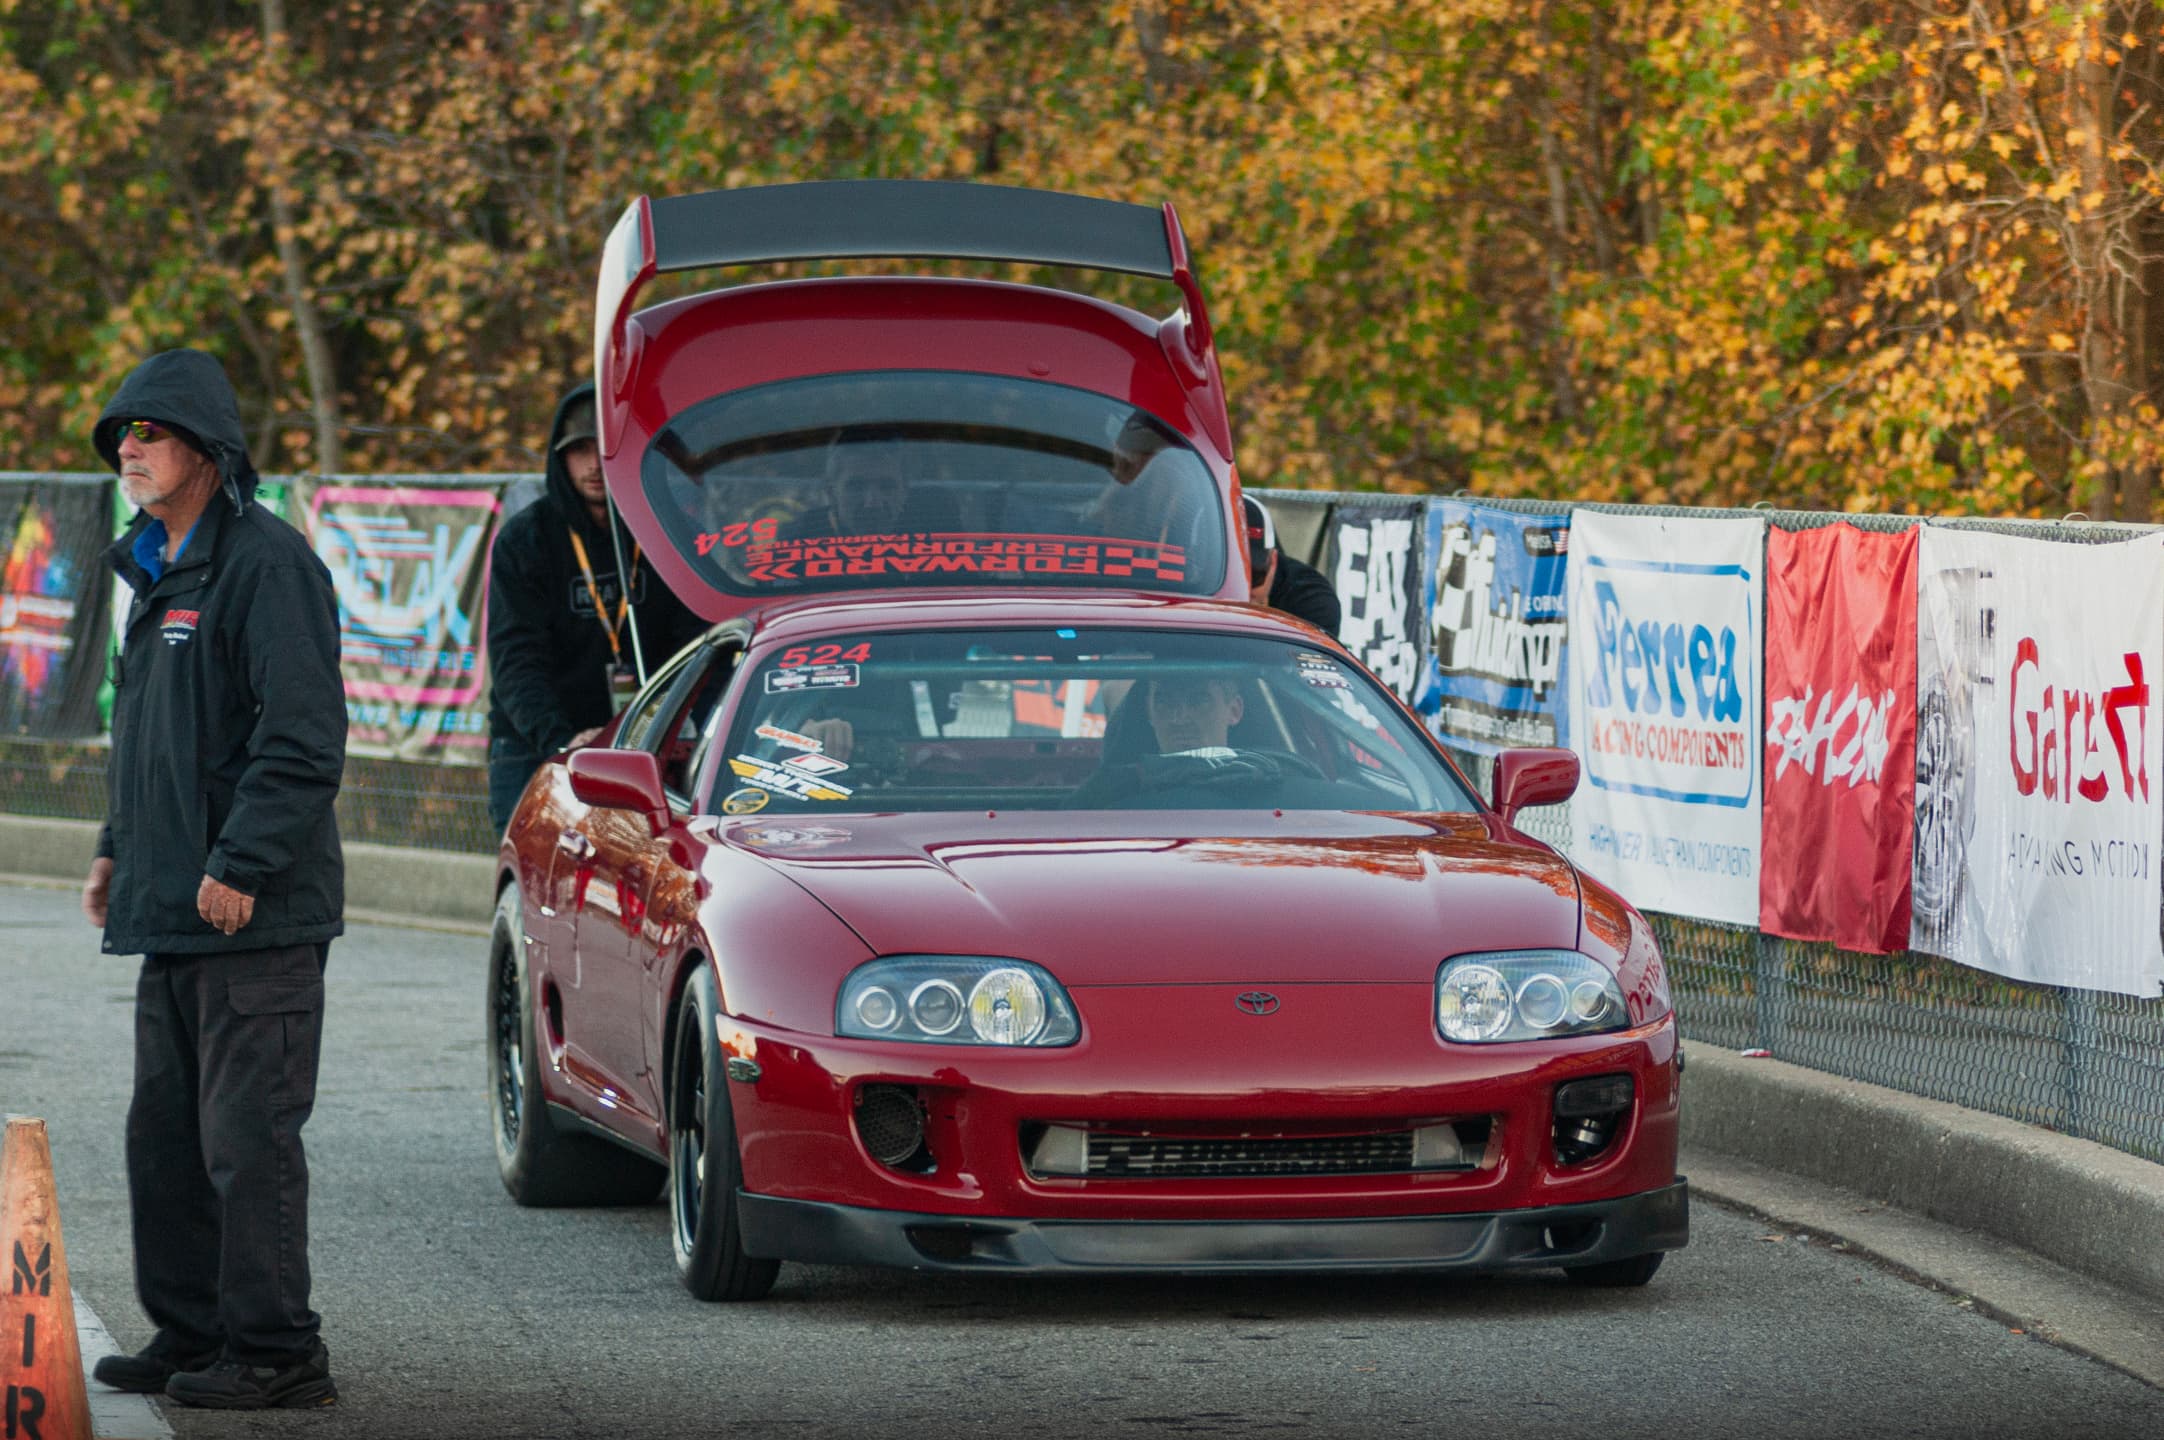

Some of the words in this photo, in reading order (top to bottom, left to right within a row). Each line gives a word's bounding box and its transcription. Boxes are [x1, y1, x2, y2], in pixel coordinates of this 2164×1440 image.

[694, 518, 778, 556] 524
[746, 534, 909, 553] FABRICATION
[745, 541, 1099, 567] PERFORMANCE
[805, 555, 1101, 578] FORWARD
[1336, 518, 1413, 647] EAT
[779, 642, 872, 669] 524
[1588, 581, 1742, 723] Ferrea
